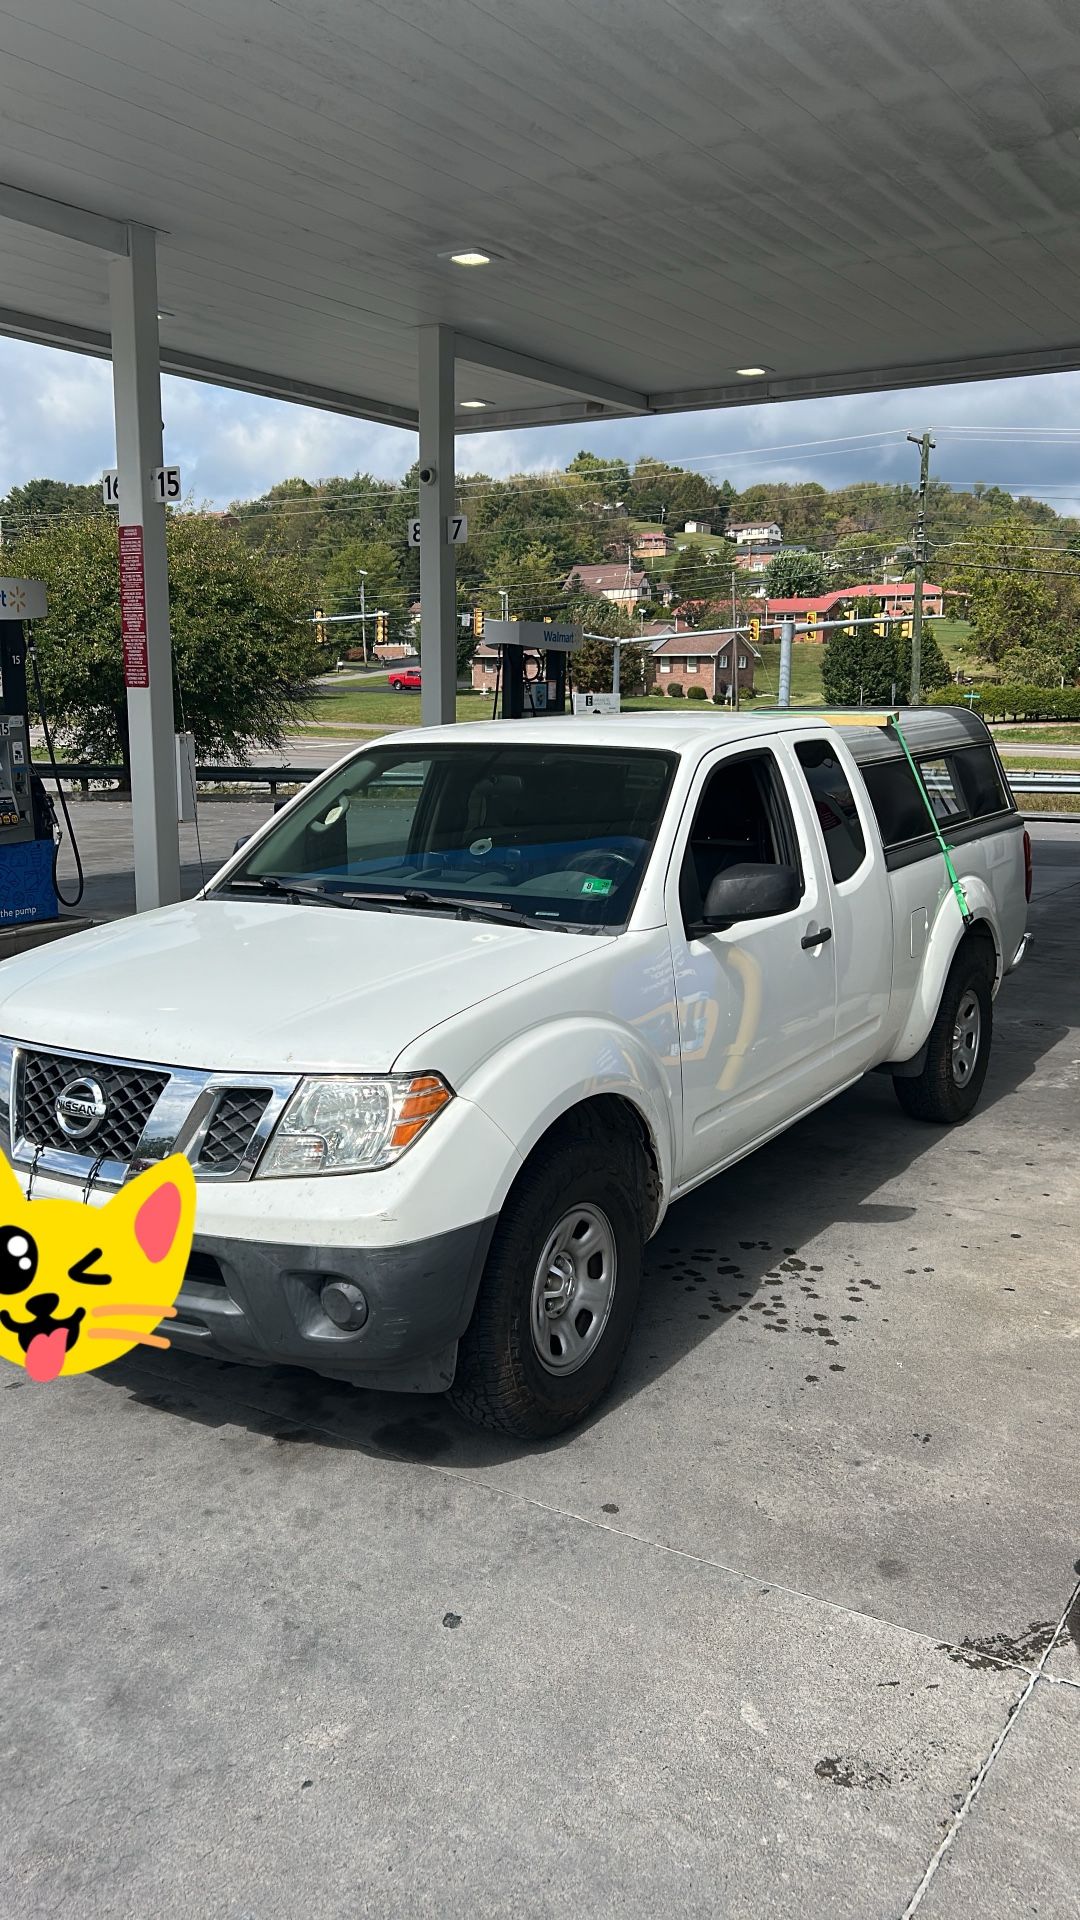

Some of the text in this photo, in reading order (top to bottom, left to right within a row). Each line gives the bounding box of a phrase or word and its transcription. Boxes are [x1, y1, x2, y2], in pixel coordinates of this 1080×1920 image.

[157, 470, 180, 497] 15
[412, 522, 421, 543] 8
[452, 519, 463, 540] 7
[543, 630, 574, 644] Walmart
[11, 655, 21, 665] 15
[0, 907, 37, 918] the pump
[56, 1099, 97, 1117] NISSAN
